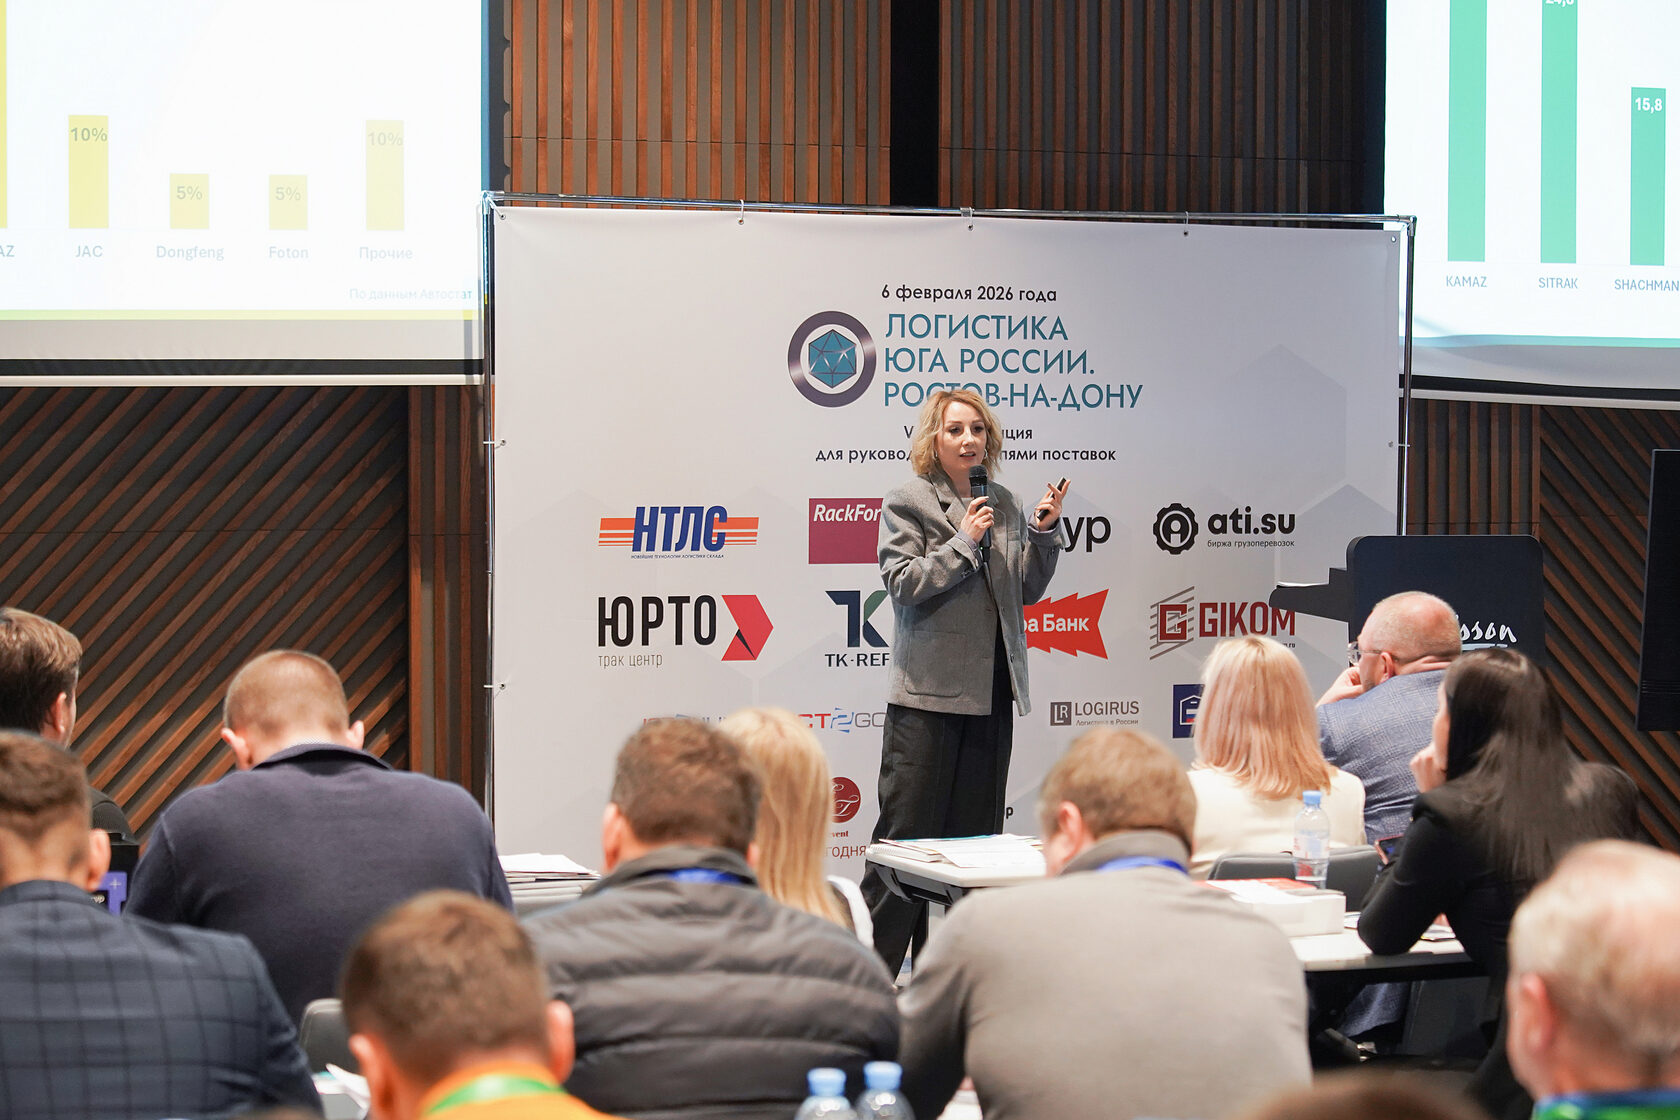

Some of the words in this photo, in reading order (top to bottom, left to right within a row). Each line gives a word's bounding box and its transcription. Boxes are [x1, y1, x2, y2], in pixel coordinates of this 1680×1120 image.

[1635, 97, 1663, 114] 15,8
[70, 127, 108, 142] 10%
[368, 131, 404, 146] 10%
[176, 185, 203, 200] 5%
[275, 186, 302, 201] 5%
[75, 245, 103, 258] JAC
[156, 245, 225, 262] Dongfeng
[268, 246, 309, 259] Foton
[359, 247, 413, 262] Прочие
[1446, 275, 1488, 288] KAMAZ
[1538, 276, 1579, 290] SITRAK
[1614, 278, 1680, 292] SHACHMAN
[881, 284, 890, 299] 6
[895, 284, 972, 303] февраля
[977, 286, 1014, 301] 2026
[1019, 289, 1057, 303] года
[885, 313, 1069, 341] ЛОГИСТИКА
[884, 347, 949, 374] ЮГА
[960, 348, 1095, 375] РОССИИ.
[815, 449, 843, 461] для
[1042, 450, 1116, 461] поставок
[1207, 505, 1296, 535] ati.su
[631, 505, 728, 552] НТЛС
[1207, 540, 1232, 548] биржа
[1234, 540, 1295, 548] грузоперевозок
[598, 594, 717, 648] ЮРТО
[1043, 613, 1090, 633] Банк
[1199, 601, 1296, 638] GIKOM
[598, 654, 625, 669] трак
[629, 654, 663, 668] центр
[1075, 700, 1140, 716] LOGIRUS
[1115, 718, 1139, 726] России
